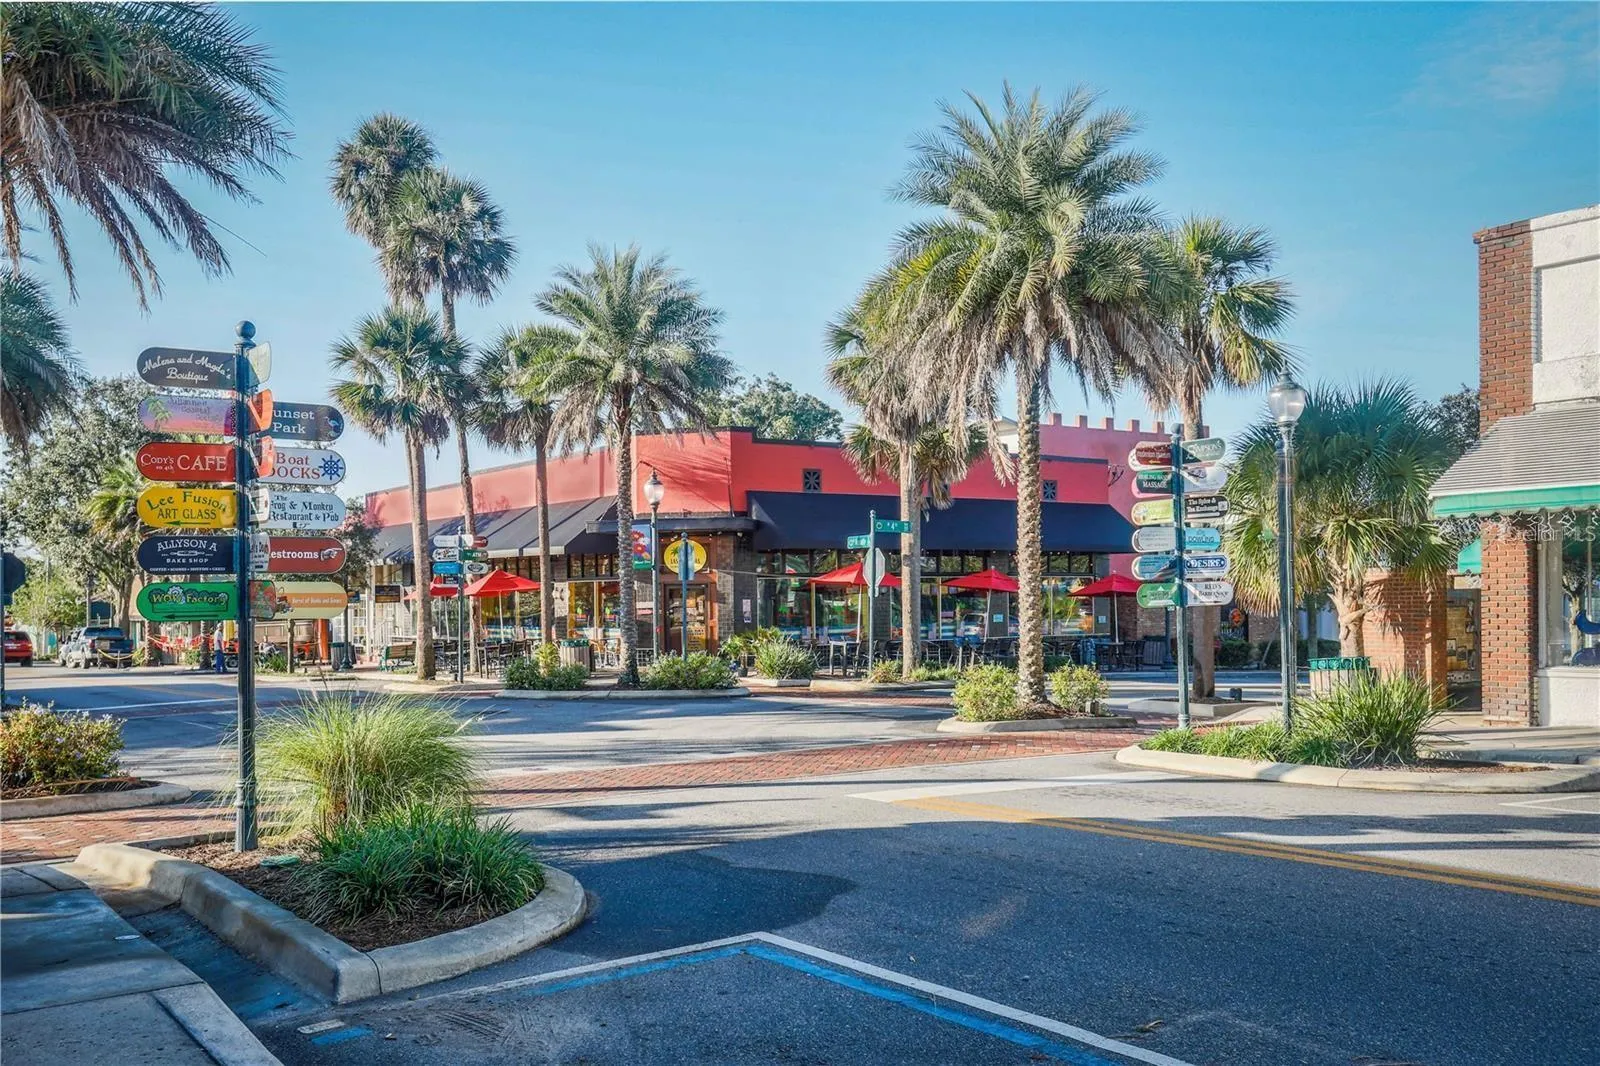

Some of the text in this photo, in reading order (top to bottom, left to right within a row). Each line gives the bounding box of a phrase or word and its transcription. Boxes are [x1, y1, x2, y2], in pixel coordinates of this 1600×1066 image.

[142, 353, 231, 379] Malena and Magda's
[166, 367, 208, 384] Boutique
[273, 409, 315, 420] unset
[273, 422, 306, 433] Park
[177, 455, 227, 471] CAFE
[277, 452, 309, 465] Boat
[146, 491, 226, 512] Lee Fusion
[289, 501, 297, 510] &
[301, 502, 333, 512] Monkey
[157, 508, 217, 519] ART GLASS
[323, 512, 339, 522] Pub
[157, 539, 218, 552] ALLYSON A
[271, 550, 319, 558] estrooms
[1190, 559, 1221, 567] DESIRE
[187, 593, 227, 605] Factory
